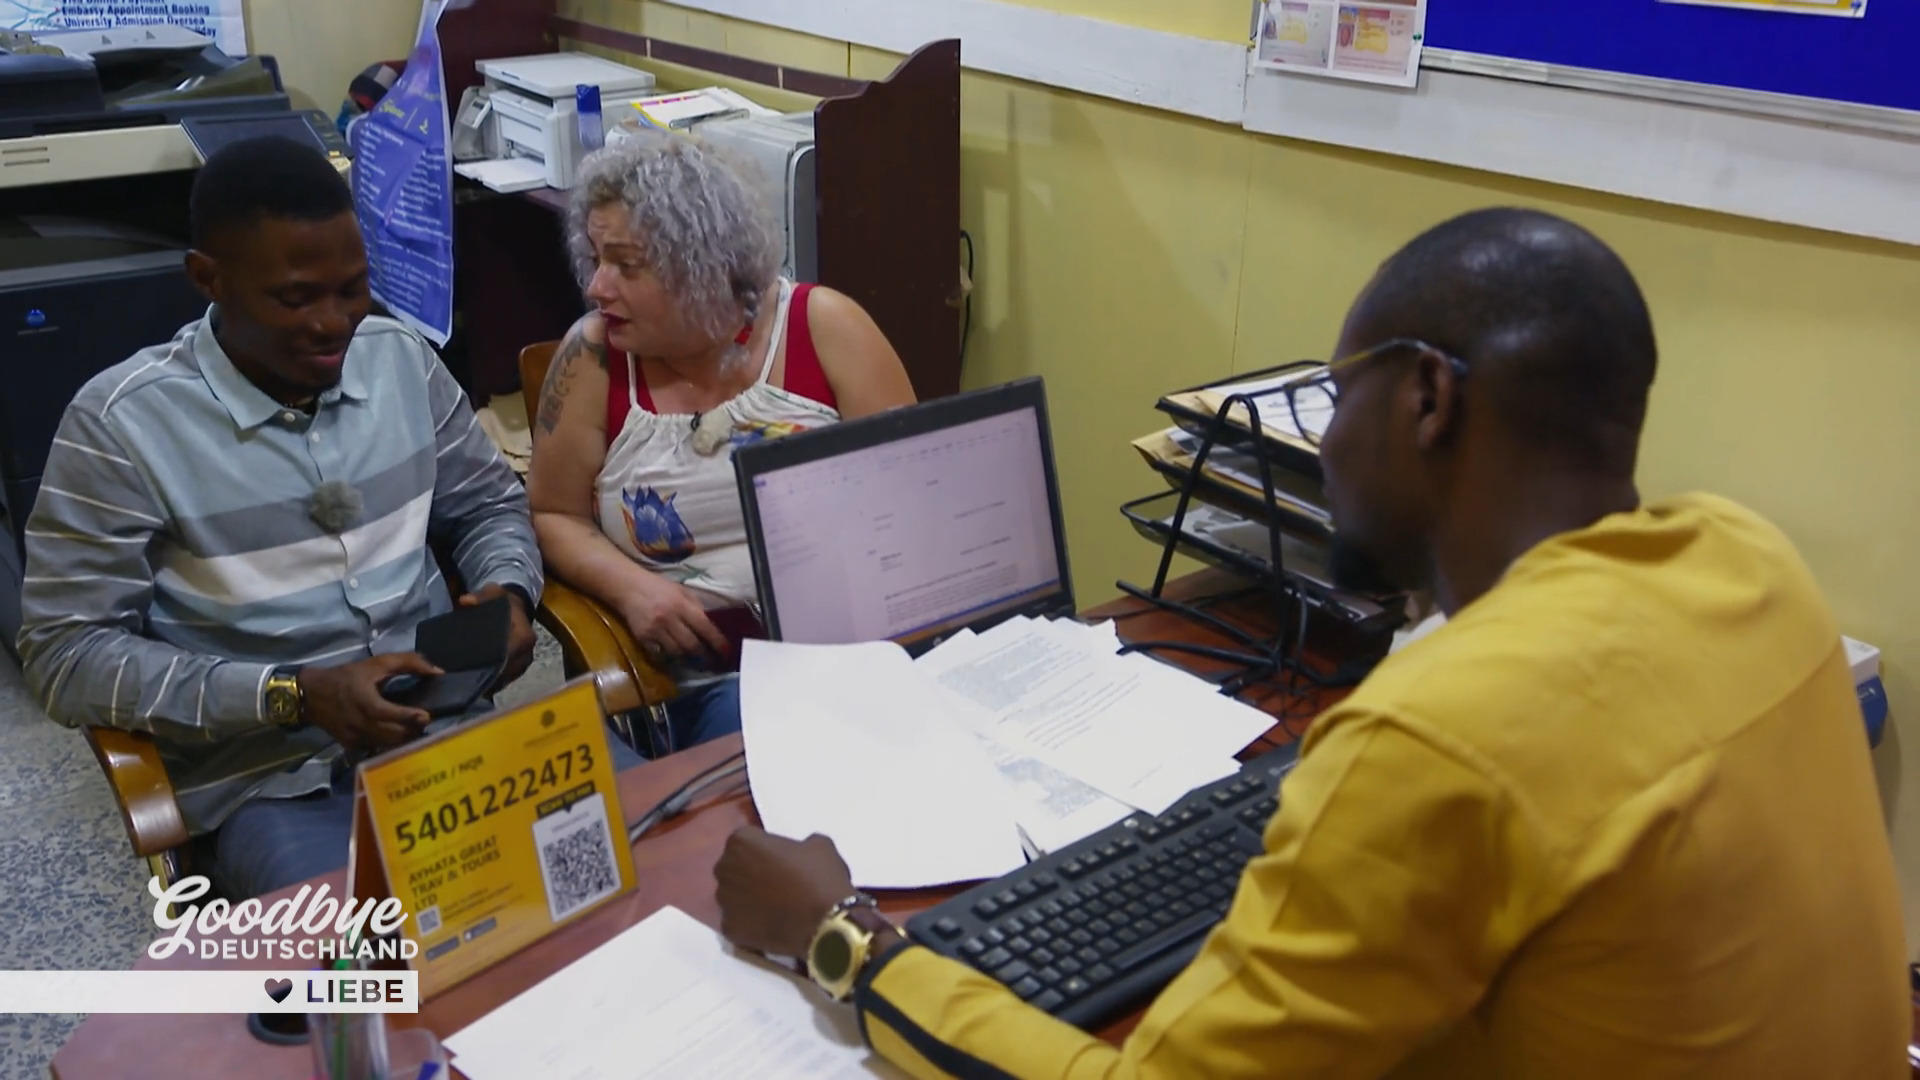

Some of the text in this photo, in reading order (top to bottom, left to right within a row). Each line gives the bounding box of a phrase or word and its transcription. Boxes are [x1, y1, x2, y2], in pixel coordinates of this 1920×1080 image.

[62, 4, 210, 17] Embassy Appointment Booking
[64, 16, 111, 29] University
[387, 769, 447, 803] TRANSFER
[394, 743, 595, 855] 5401222473
[459, 834, 498, 860] GREAT
[461, 848, 501, 874] TOURS
